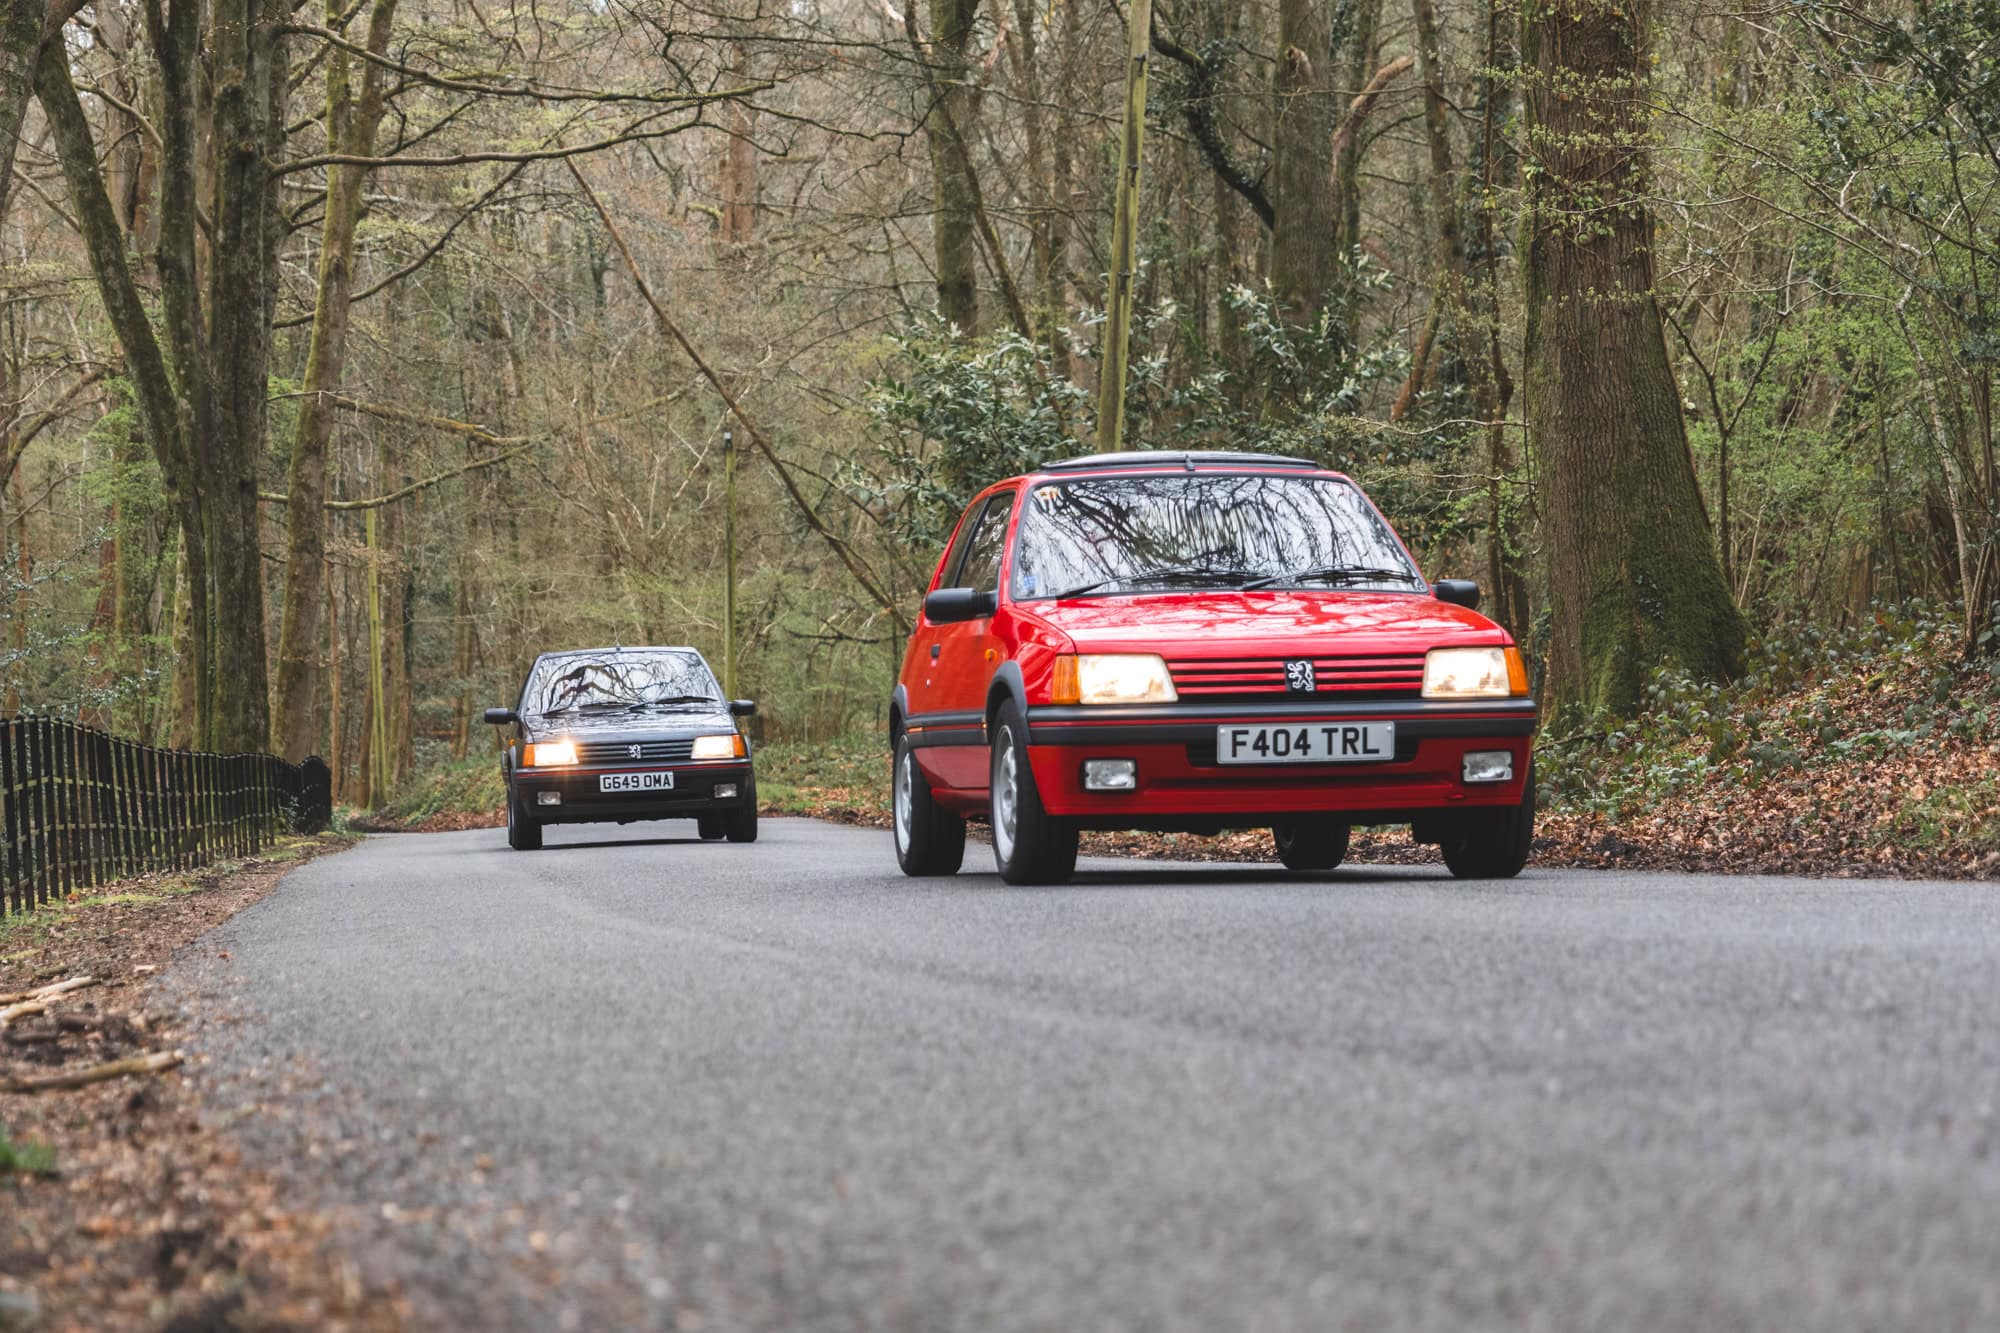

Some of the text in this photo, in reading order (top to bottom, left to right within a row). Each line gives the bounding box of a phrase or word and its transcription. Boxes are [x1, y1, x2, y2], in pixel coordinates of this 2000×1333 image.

[1231, 726, 1380, 758] F404 TRL
[602, 775, 640, 790] G649
